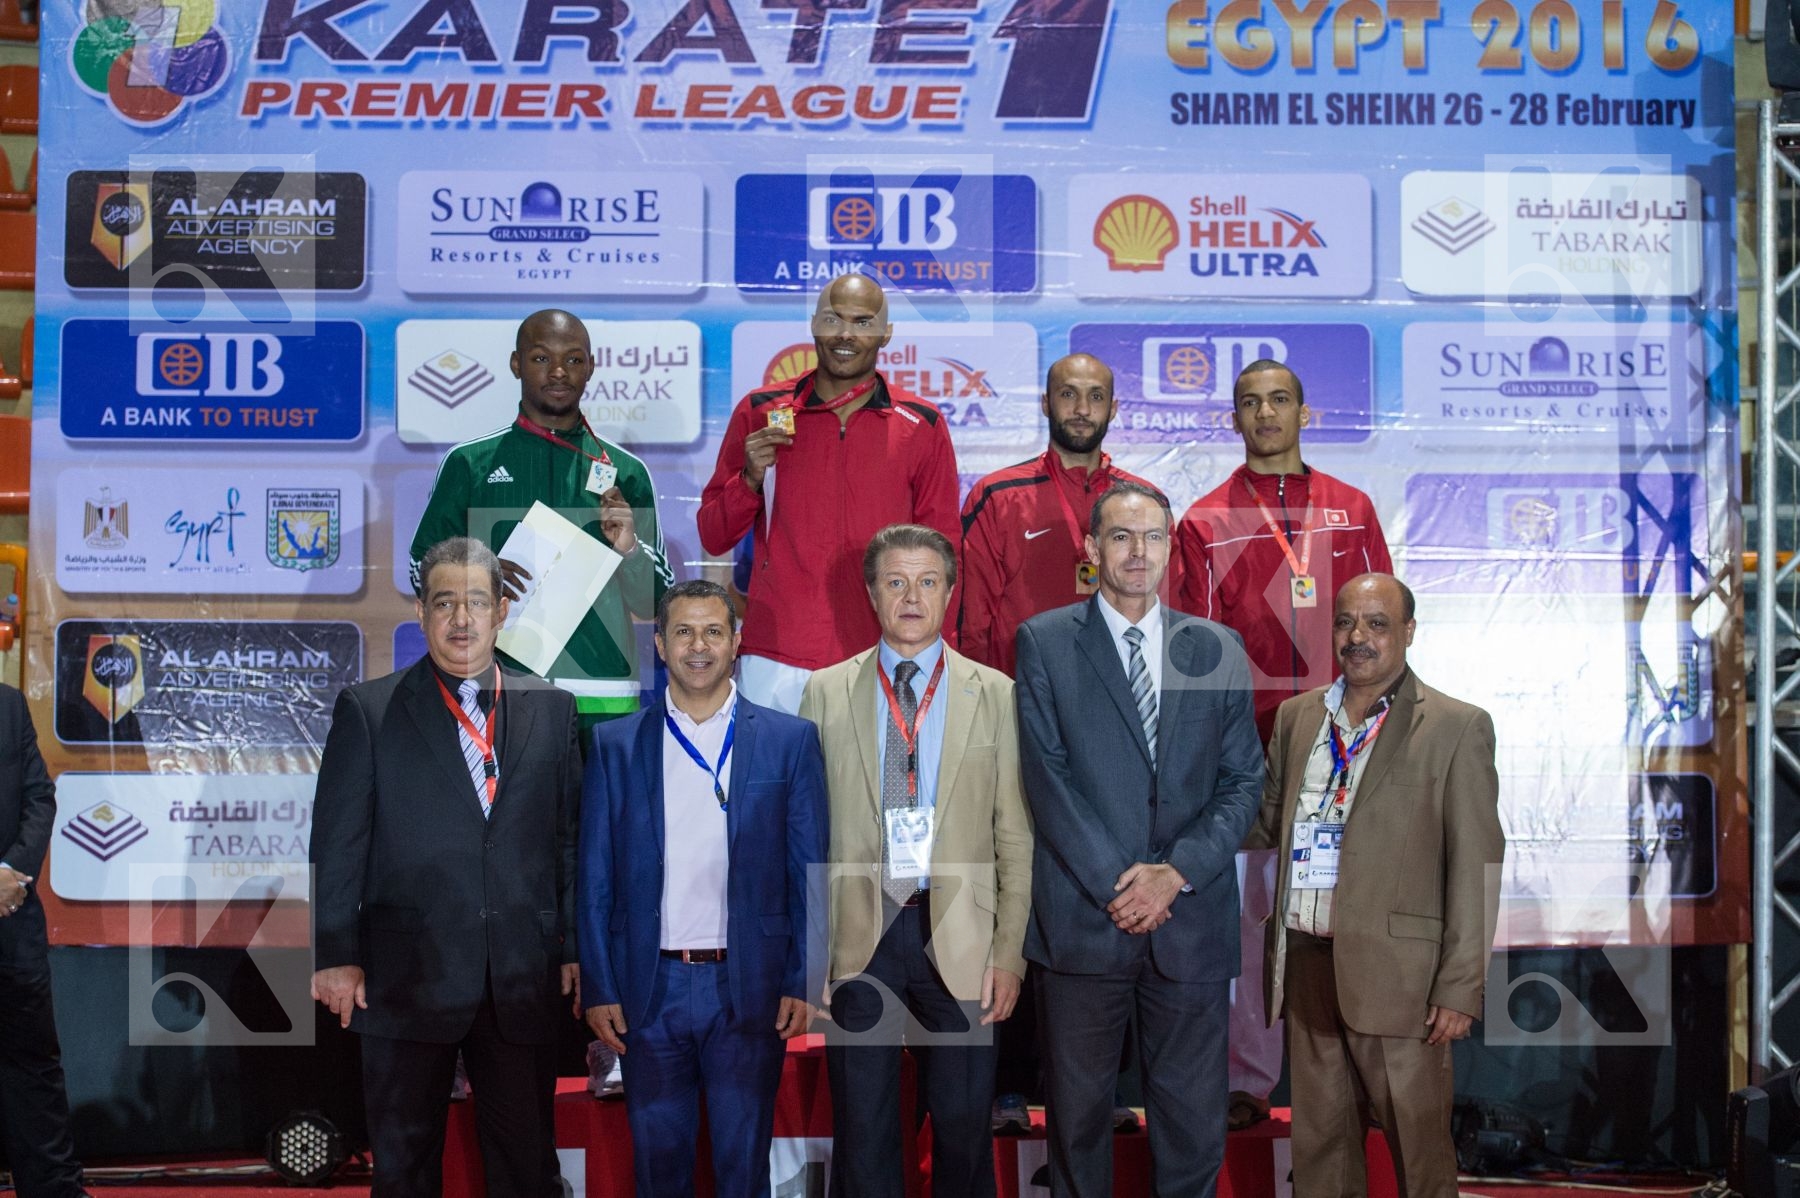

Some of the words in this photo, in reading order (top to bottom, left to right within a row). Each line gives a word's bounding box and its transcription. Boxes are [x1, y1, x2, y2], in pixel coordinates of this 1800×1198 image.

[254, 0, 980, 63] KARATE
[1166, 0, 1440, 69] EGYPT
[1471, 0, 1699, 70] 2016
[241, 82, 605, 117] PREMIER
[634, 84, 963, 119] LEAGUE
[1171, 92, 1279, 125] SHARM
[1288, 93, 1318, 125] EL
[1326, 93, 1435, 125] SHEIKH
[1444, 93, 1483, 125] 26
[1509, 93, 1548, 126] 28
[1556, 93, 1696, 129] February
[167, 199, 336, 216] AL-AHRAM
[1190, 196, 1246, 216] Shell
[1516, 198, 1611, 226] القابضة
[1617, 199, 1687, 228] تبارك
[167, 219, 335, 236] ADVERTISING
[809, 187, 958, 251] CIB
[493, 227, 538, 240] GRAND
[539, 227, 588, 240] SELECT
[1188, 219, 1324, 248] HELIX
[1531, 231, 1671, 253] TABARAK
[197, 239, 304, 255] AGENCY
[430, 247, 522, 263] Resorts
[537, 248, 552, 263] &
[567, 248, 660, 264] Cruises
[517, 269, 572, 280] EGYPT
[774, 261, 791, 279] A
[798, 261, 865, 280] BANK
[873, 261, 905, 280] TO
[912, 261, 992, 280] TRUST
[1190, 252, 1319, 277] ULTRA
[1558, 256, 1645, 273] HOLDING
[135, 332, 285, 397] CIB
[616, 346, 689, 374] تبارك
[1502, 382, 1547, 395] GRAND
[1549, 382, 1596, 395] SELECT
[101, 407, 117, 426] A
[124, 407, 192, 426] BANK
[200, 408, 232, 427] TO
[240, 408, 318, 427] TRUST
[1441, 402, 1533, 417] Resorts
[1550, 403, 1562, 417] &
[1577, 403, 1669, 418] Cruises
[1132, 412, 1199, 429] BANK
[487, 474, 514, 483] adidas
[160, 650, 329, 668] AL-AHRAM
[169, 800, 267, 828] القابضة
[185, 834, 308, 857] TABARA
